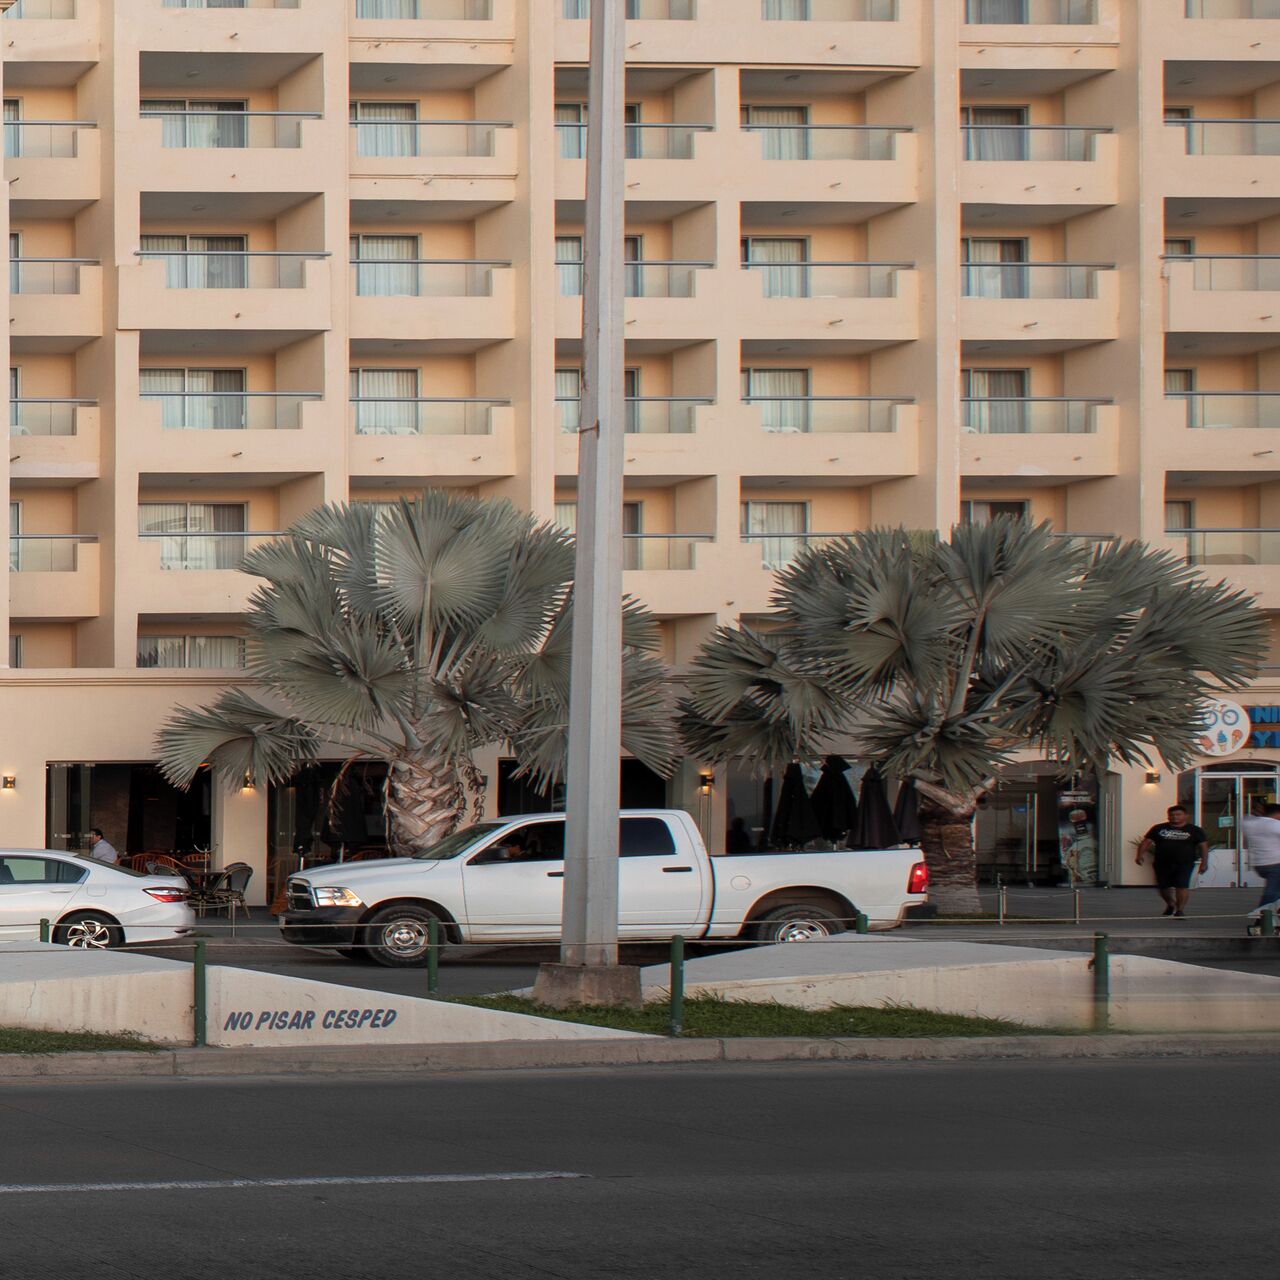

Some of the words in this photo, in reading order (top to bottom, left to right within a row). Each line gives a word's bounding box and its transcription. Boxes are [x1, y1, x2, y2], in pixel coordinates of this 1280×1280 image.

[1253, 705, 1280, 724] NI
[223, 1010, 253, 1032] NO
[255, 1009, 316, 1031] PISAR
[322, 1008, 397, 1030] CESPED
